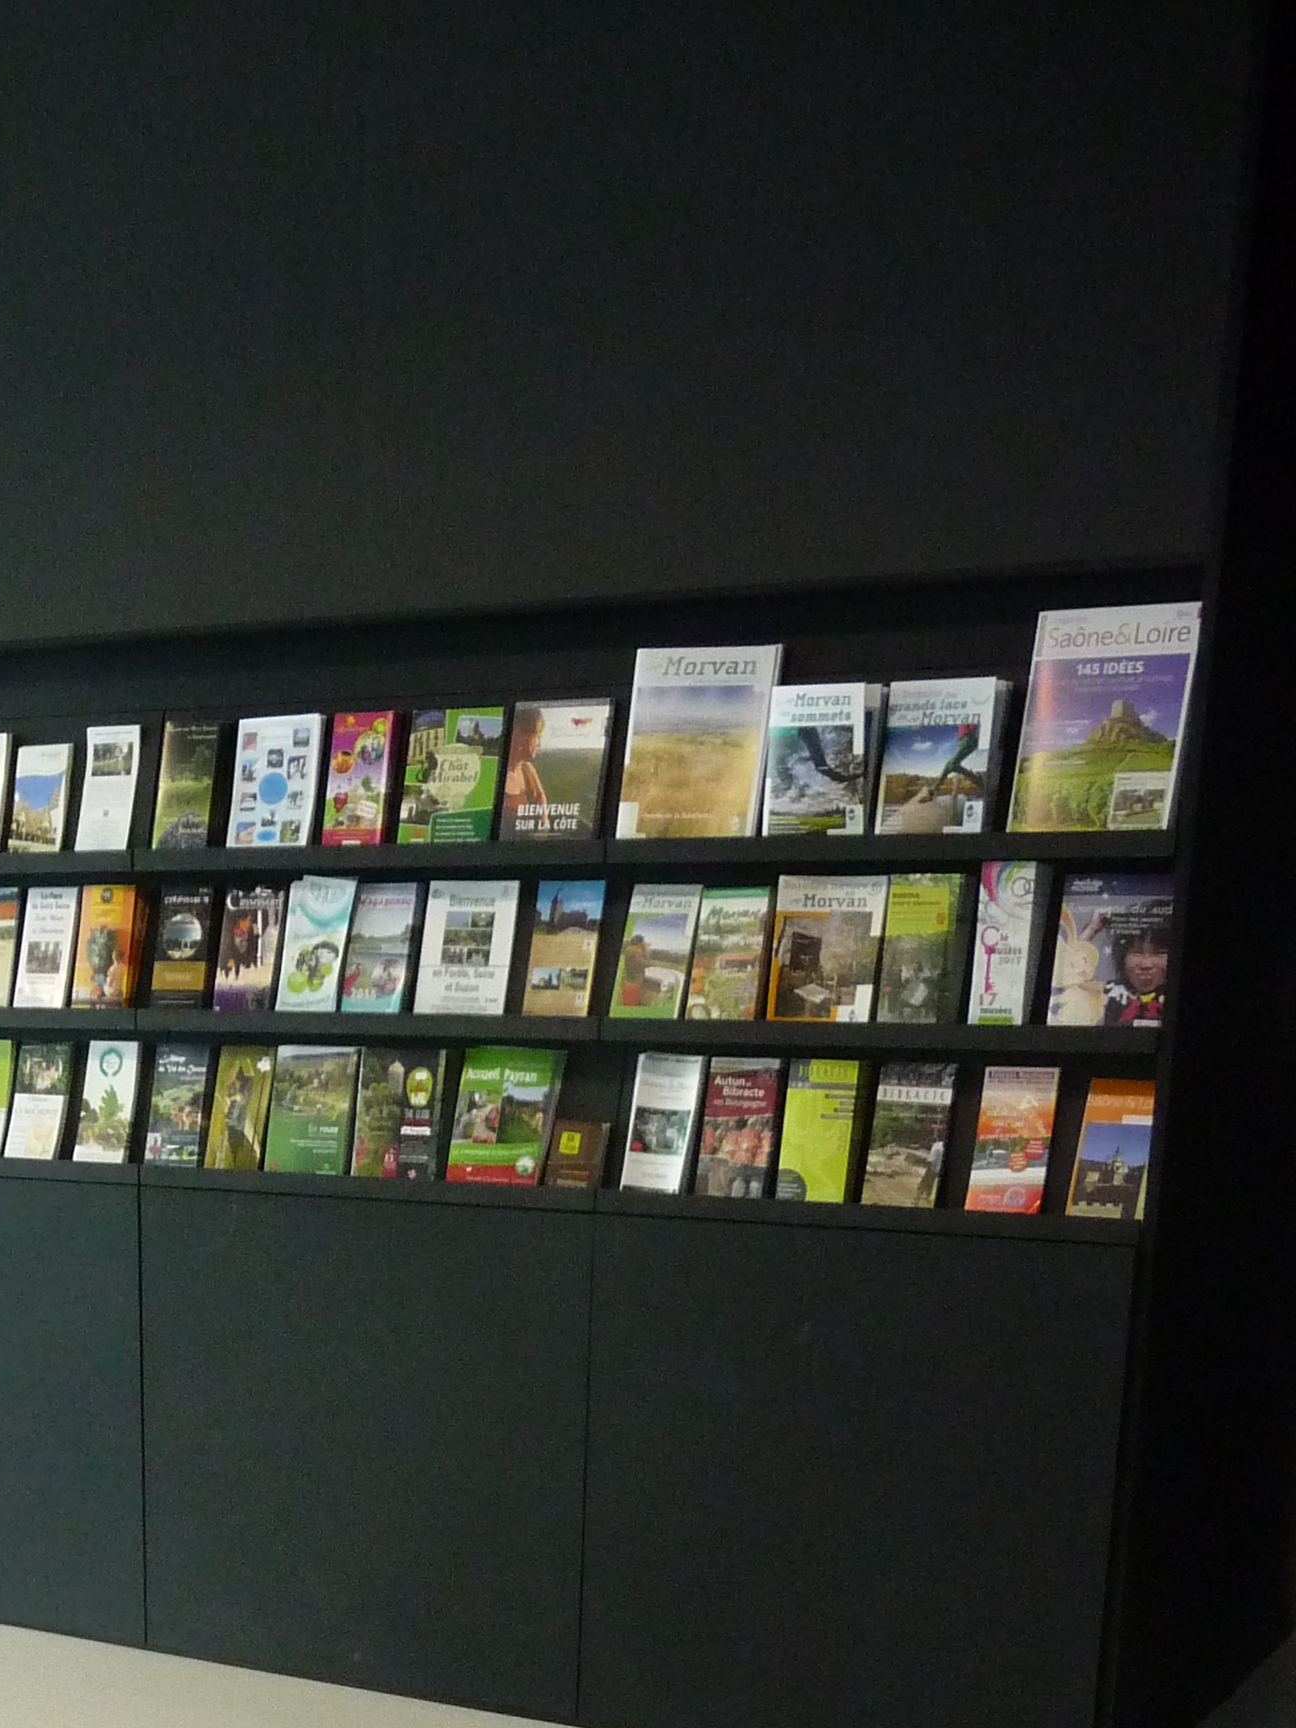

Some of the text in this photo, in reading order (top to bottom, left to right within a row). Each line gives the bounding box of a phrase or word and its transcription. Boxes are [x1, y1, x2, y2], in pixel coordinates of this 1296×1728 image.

[1047, 621, 1191, 649] Saône&Loire
[662, 656, 757, 677] Morvan
[794, 693, 851, 707] Morvan
[791, 710, 851, 722] sommets
[920, 711, 981, 726] Morvan
[517, 803, 580, 816] BIENVENUE
[515, 816, 578, 830] SUR LA CÔTE
[802, 893, 867, 908] Morvan
[714, 1076, 746, 1086] Autun
[722, 1086, 765, 1098] Bibracte
